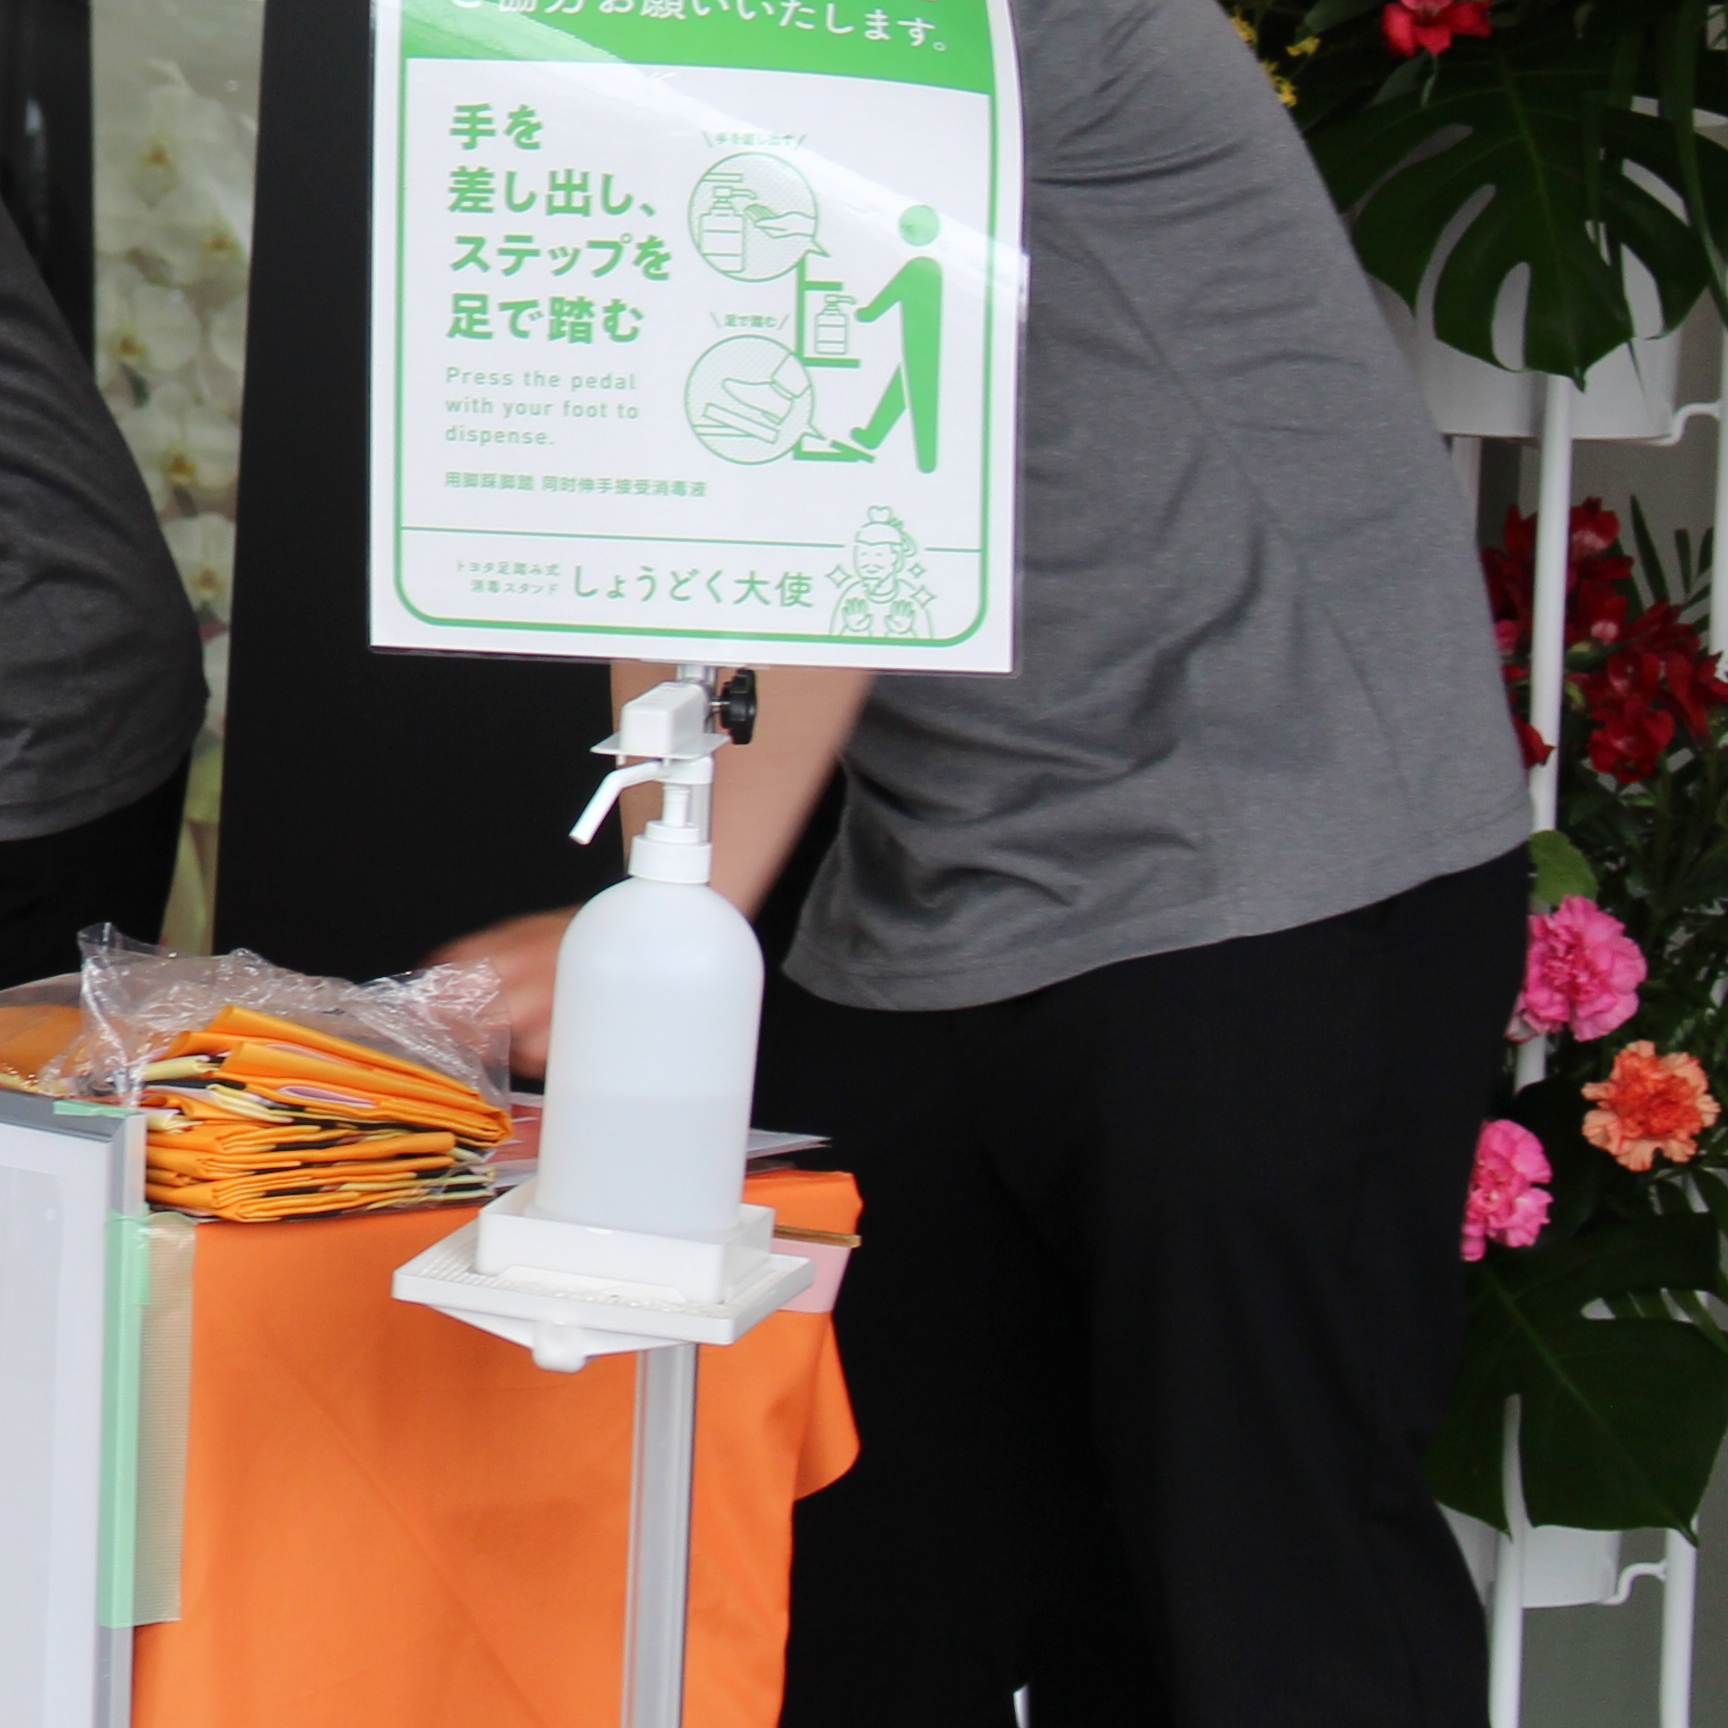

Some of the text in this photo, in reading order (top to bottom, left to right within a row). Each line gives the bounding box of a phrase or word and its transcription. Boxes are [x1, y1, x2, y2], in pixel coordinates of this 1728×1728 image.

[449, 103, 545, 152] 手を
[448, 166, 659, 220] 差し出し、
[450, 232, 672, 281] ステップを
[446, 293, 644, 344] 足で踏む
[445, 365, 637, 392] Press the pedal
[445, 397, 640, 420] with your foot to
[445, 425, 555, 447] dispense.
[573, 565, 815, 609] しょうどく大使
